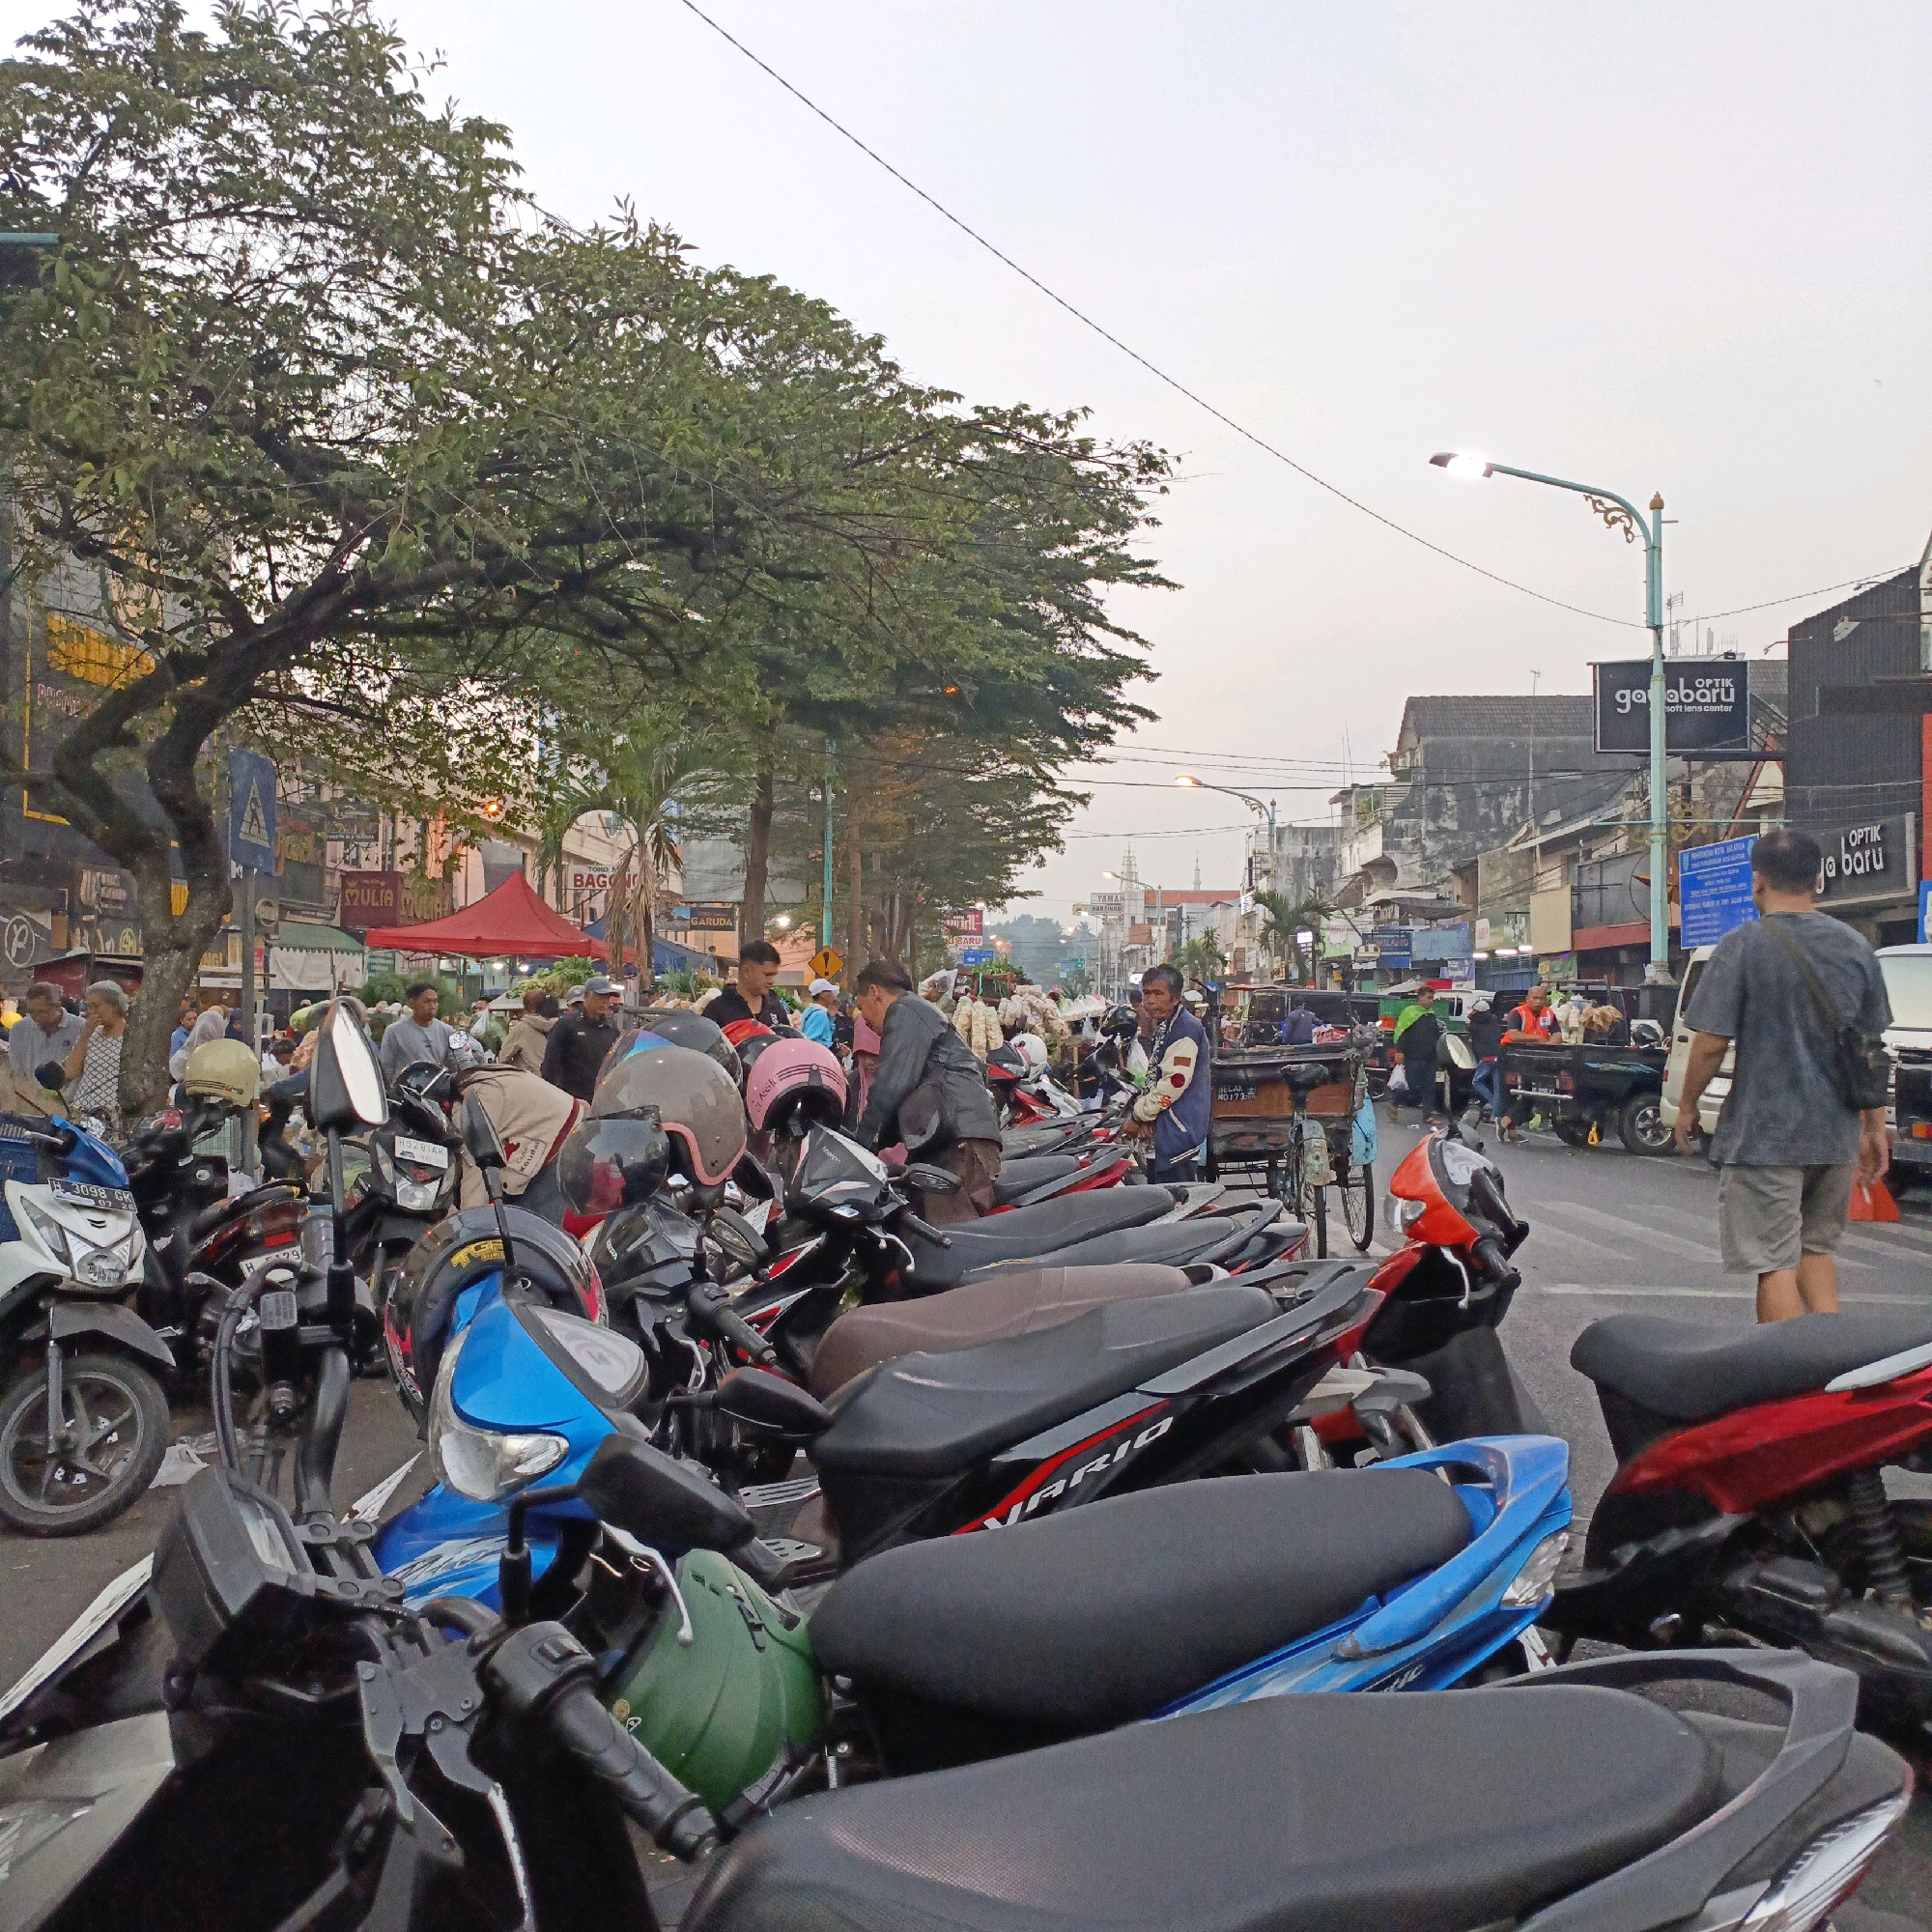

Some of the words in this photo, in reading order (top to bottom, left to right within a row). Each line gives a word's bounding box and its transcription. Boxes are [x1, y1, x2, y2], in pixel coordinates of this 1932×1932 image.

[1695, 678, 1734, 688] OPTIK
[1615, 678, 1735, 714] gaabaru
[1664, 704, 1683, 713] soft
[1684, 704, 1703, 713] lens
[1703, 704, 1733, 713] center
[1849, 824, 1882, 847] OPTIK
[1840, 837, 1885, 876] baru
[345, 888, 394, 907] MULIA
[1097, 895, 1124, 903] YAMAH
[691, 917, 733, 926] GARUDA
[53, 1180, 61, 1192] H
[71, 1183, 107, 1199] 3098
[114, 1190, 132, 1203] GK
[243, 1262, 256, 1273] H
[982, 1416, 1174, 1529] VARIO
